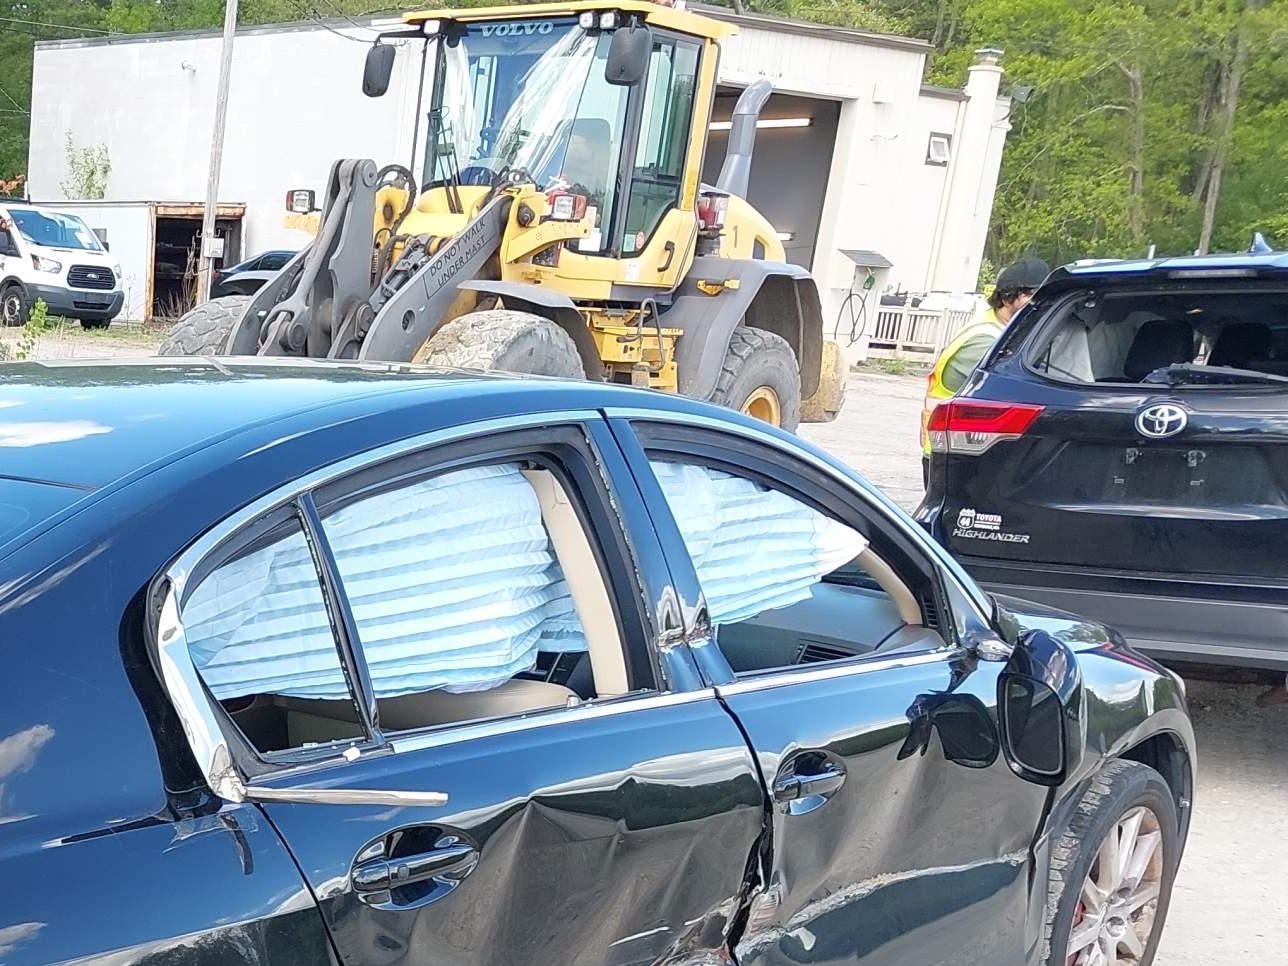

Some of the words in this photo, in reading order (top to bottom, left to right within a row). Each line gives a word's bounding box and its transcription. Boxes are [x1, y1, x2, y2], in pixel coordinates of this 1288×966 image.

[479, 22, 554, 37] VOLVO
[430, 260, 443, 277] DO
[443, 239, 463, 263] NOT
[463, 217, 486, 244] WALK
[437, 256, 467, 287] UNDER
[465, 235, 486, 260] MAST
[959, 517, 971, 527] 44
[976, 513, 1002, 522] TOYOTA
[952, 528, 1031, 544] HIGHLANDER
